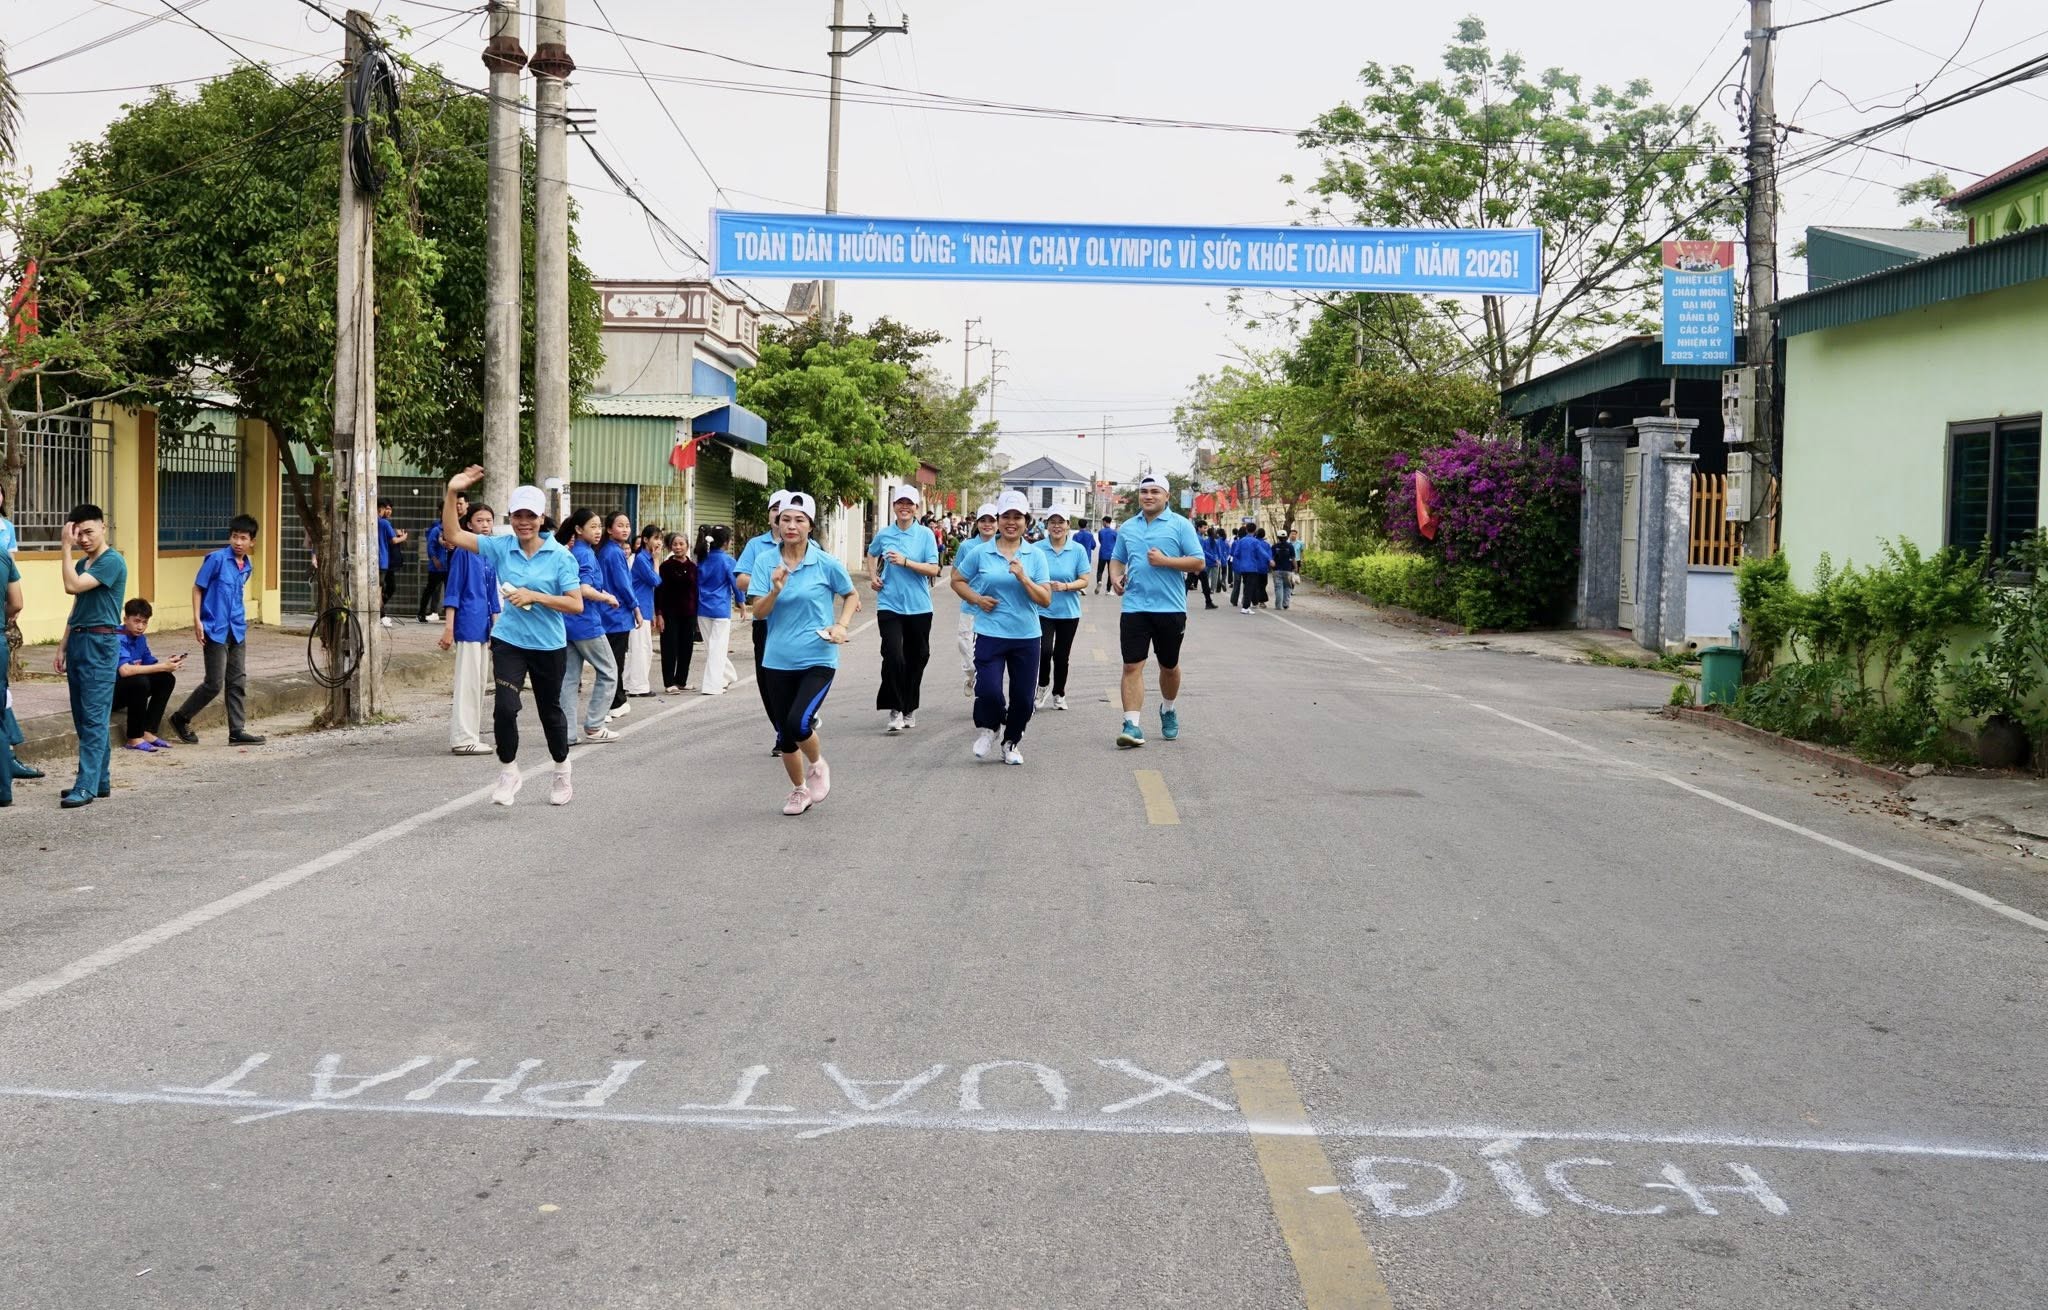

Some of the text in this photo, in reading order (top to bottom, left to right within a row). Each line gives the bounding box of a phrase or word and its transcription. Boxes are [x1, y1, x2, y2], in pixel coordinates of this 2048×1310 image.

[734, 225, 786, 263] TOÀN
[792, 229, 832, 263] DÂN
[838, 222, 905, 264] HƯỞNG
[910, 226, 957, 265] ỨNG:
[1029, 235, 1080, 272] CHẠY
[1085, 235, 1172, 269] OLYMPIC
[1177, 234, 1196, 269] VÌ
[1202, 233, 1241, 270] SỨC
[1247, 231, 1298, 272] KHỎE
[1304, 239, 1355, 274] TOÀN
[1415, 241, 1460, 277] NĂM
[1465, 249, 1519, 278] 2026!
[1675, 275, 1723, 286] NHIỆT LIỆT
[1682, 300, 1716, 311] ĐẠI HỘI
[1707, 312, 1720, 323] BỘ
[1671, 351, 1694, 360] 2025
[1702, 351, 1728, 360] 2030!
